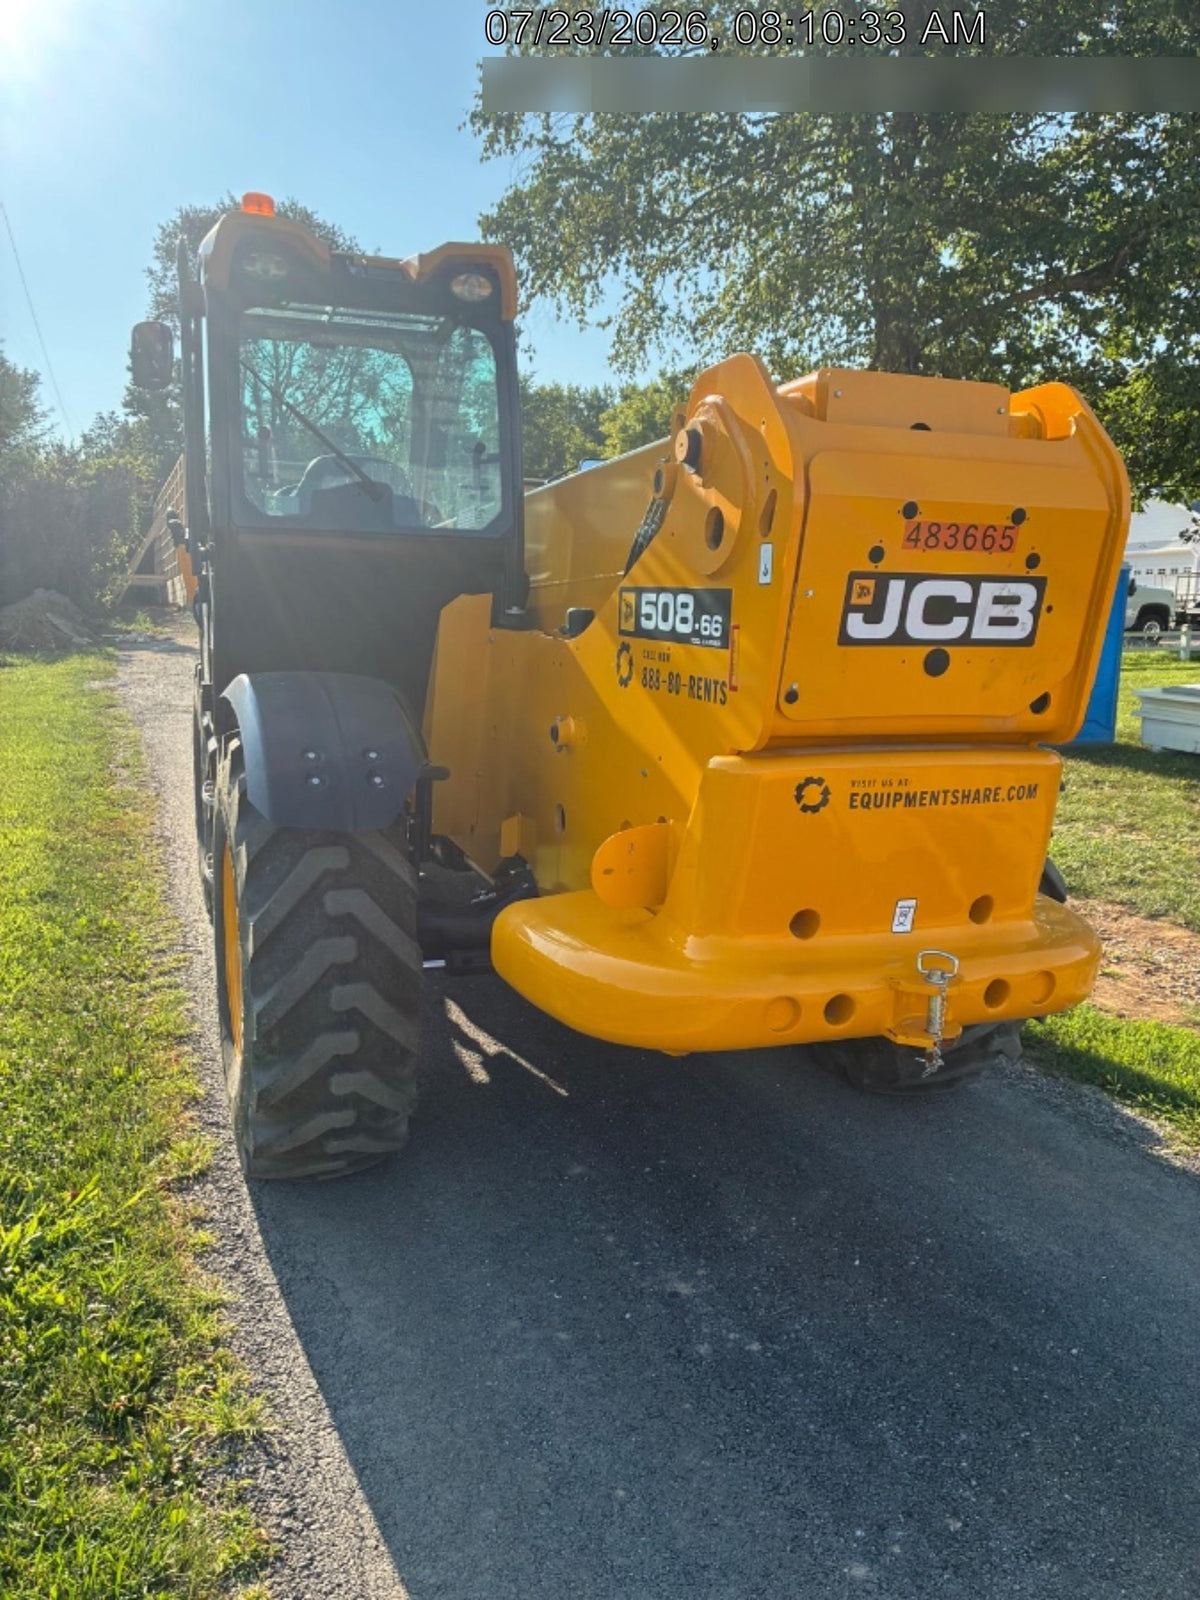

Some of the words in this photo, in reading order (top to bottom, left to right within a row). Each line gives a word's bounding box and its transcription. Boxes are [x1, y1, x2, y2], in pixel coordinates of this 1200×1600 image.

[905, 522, 1016, 552] 483665
[846, 579, 1038, 640] JCB
[641, 666, 728, 706] 888-80-RENTS
[849, 783, 1039, 810] EQUIPMENTSHARE.COM
[850, 779, 877, 789] VISIT
[881, 779, 894, 788] US
